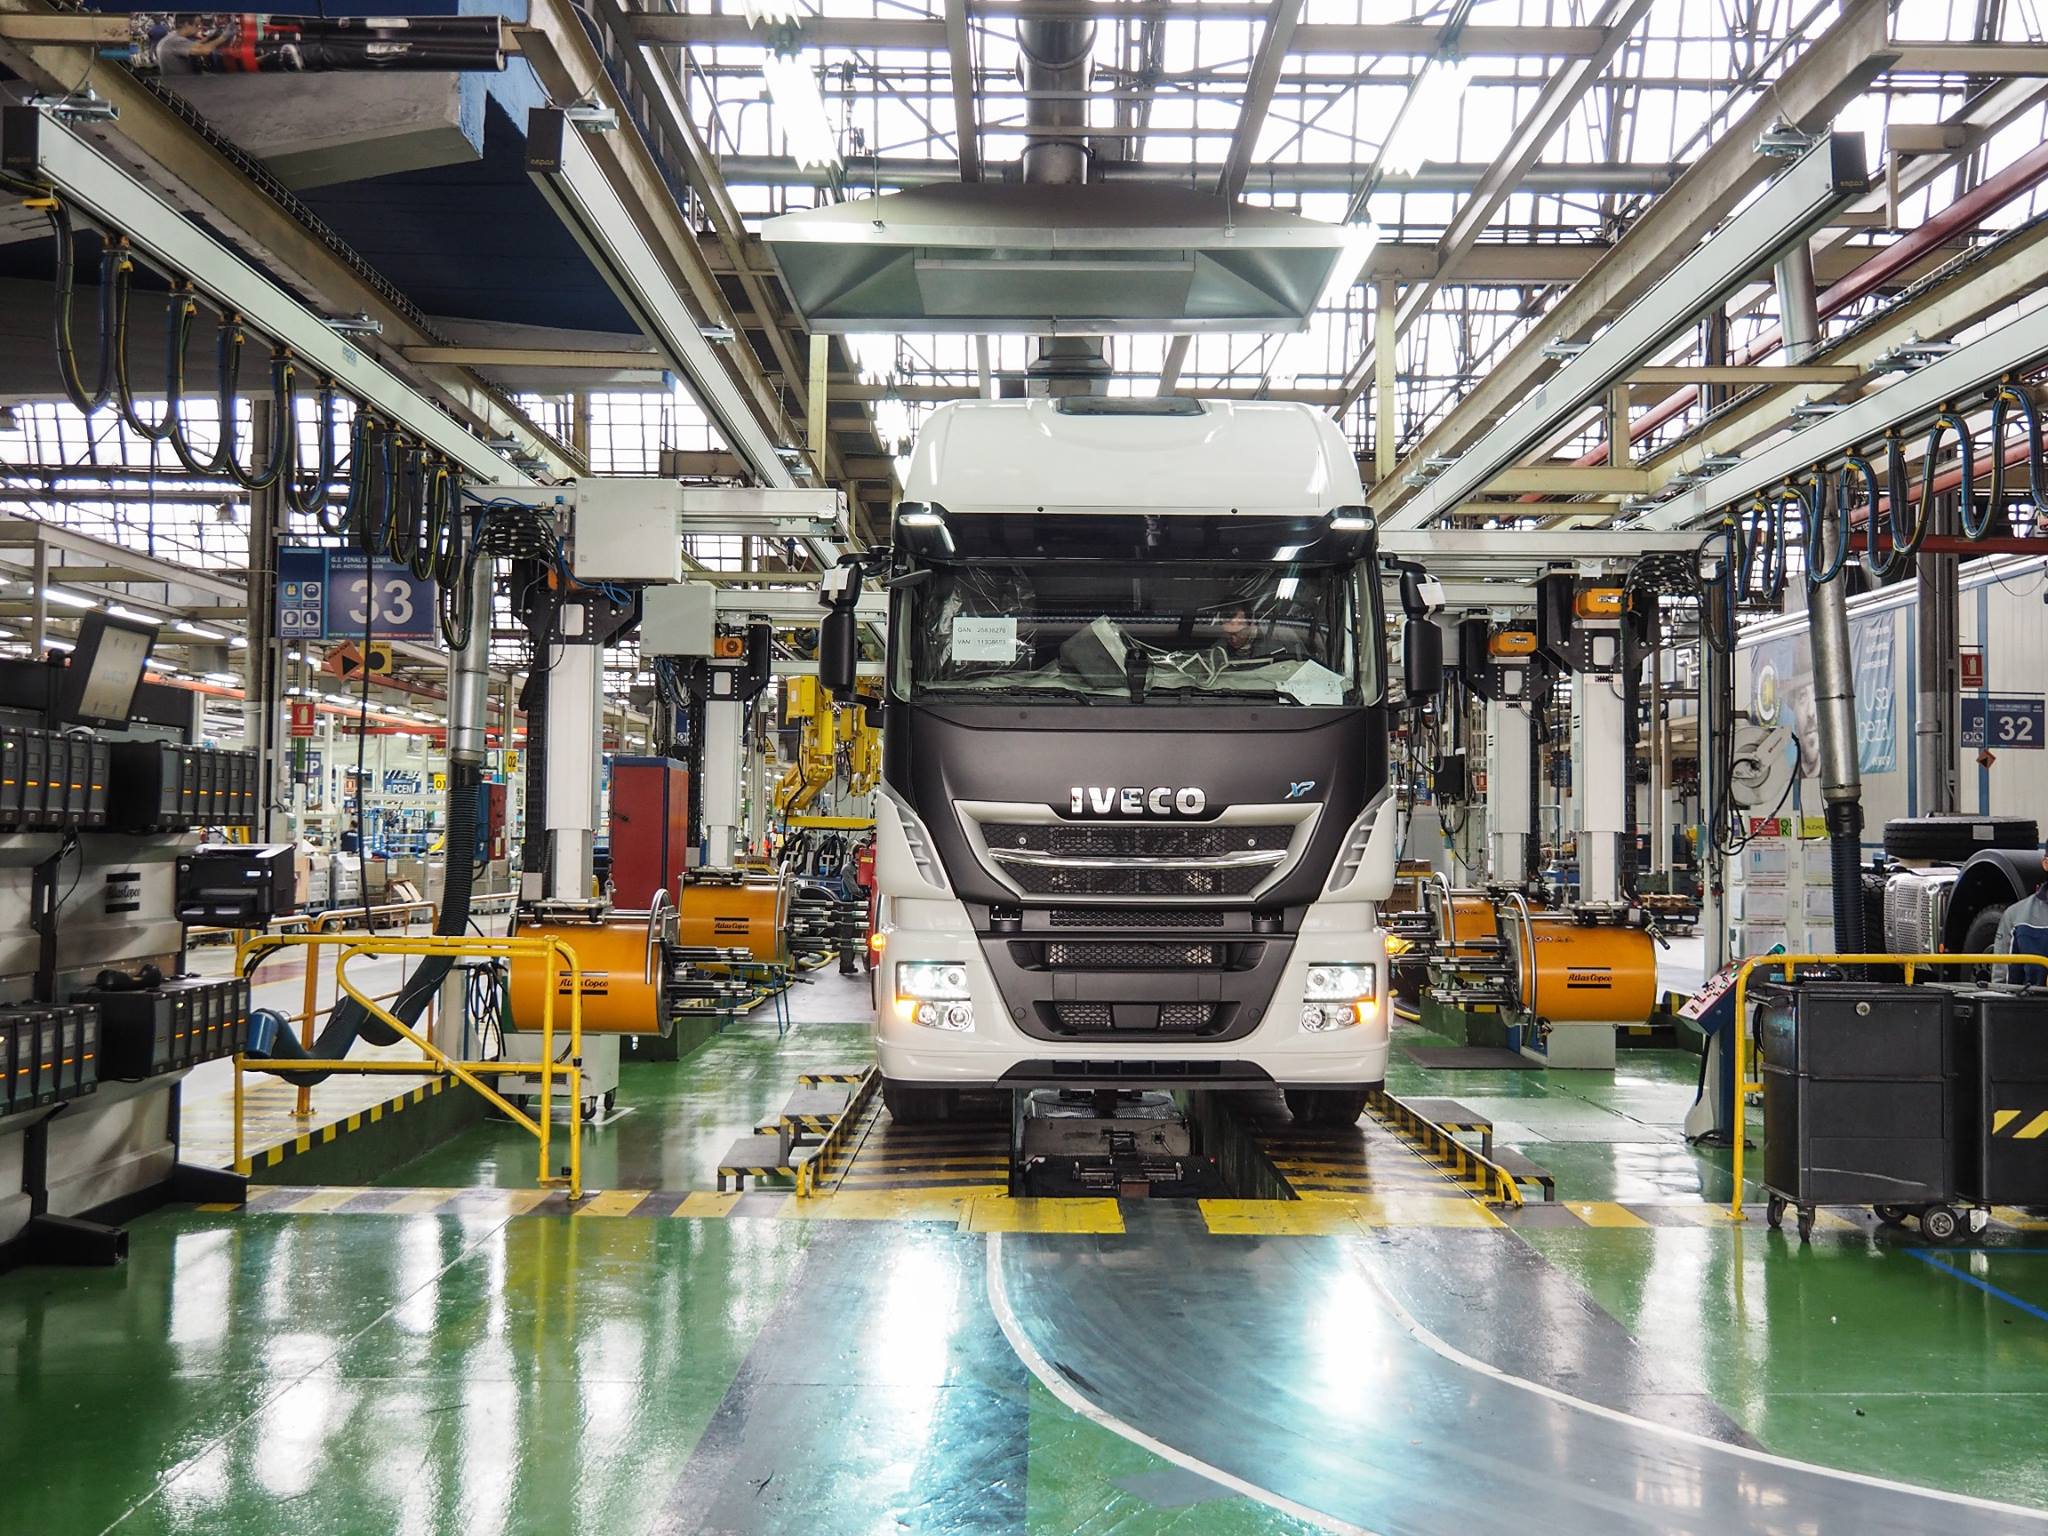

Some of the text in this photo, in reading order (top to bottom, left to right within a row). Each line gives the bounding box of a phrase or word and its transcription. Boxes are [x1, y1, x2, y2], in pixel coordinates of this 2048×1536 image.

[349, 579, 414, 625] 33
[1857, 713, 1889, 745] beza
[1998, 716, 2033, 741] 32
[1071, 787, 1207, 814] IVECO
[1281, 780, 1315, 799] XP
[731, 922, 749, 930] Copco
[584, 978, 608, 988] Copco
[1568, 974, 1612, 983] Atlas Copco
